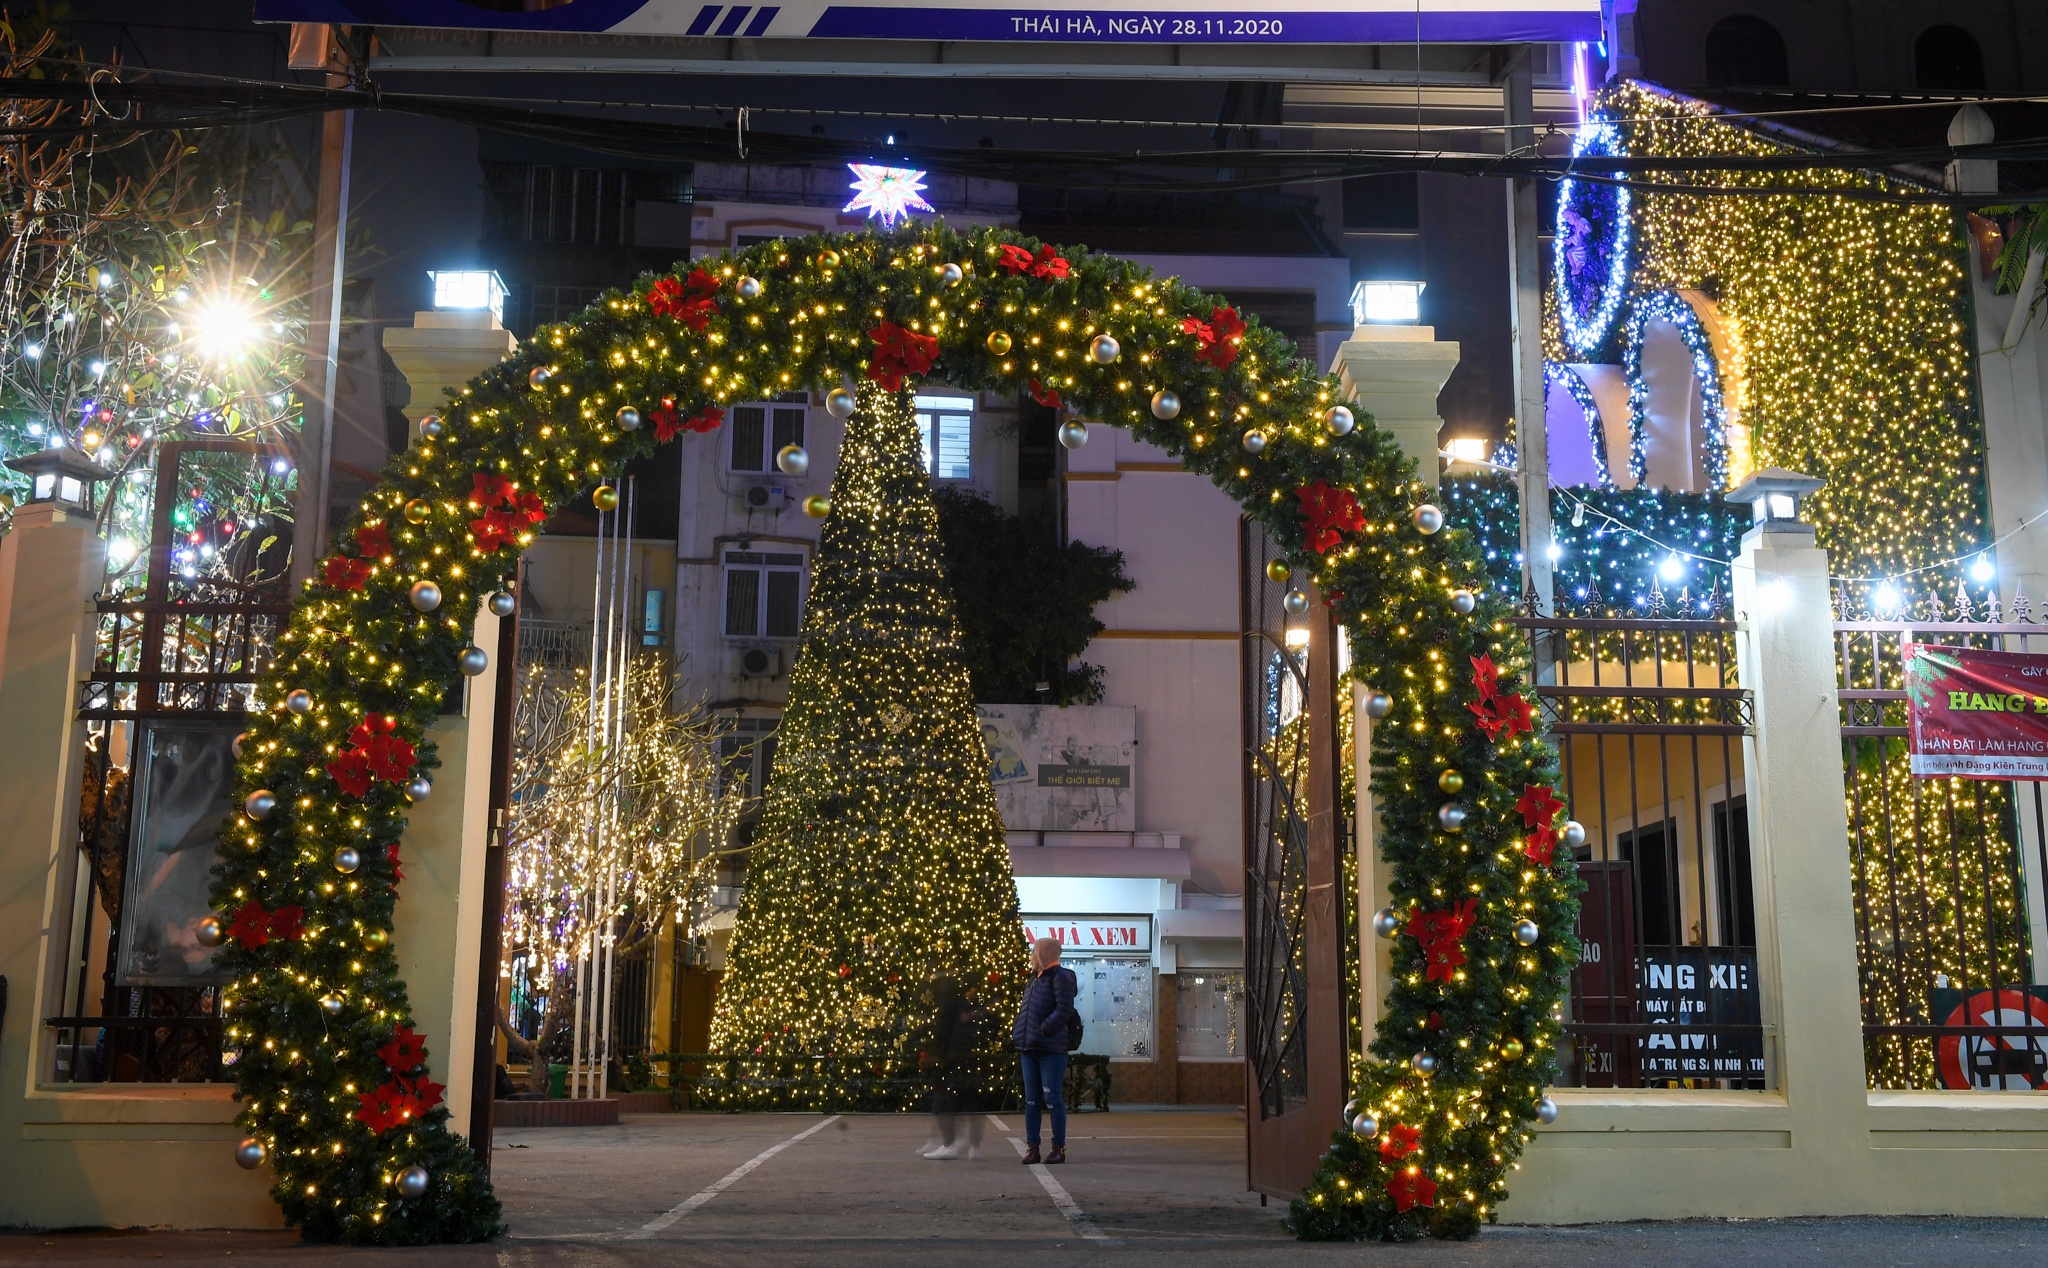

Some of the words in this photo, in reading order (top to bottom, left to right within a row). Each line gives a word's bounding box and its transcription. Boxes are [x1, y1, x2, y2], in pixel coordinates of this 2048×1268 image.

[1011, 15, 1060, 34] THÁI
[1066, 15, 1102, 36] HÀ,
[1108, 16, 1166, 35] NGÀY
[1172, 19, 1283, 36] 28.11.2020
[2021, 666, 2043, 676] GÂY
[1948, 691, 2026, 713] HANG
[1918, 738, 1950, 752] NHẬN
[1953, 738, 1975, 752] ĐẶT
[1978, 739, 2005, 751] LÀM
[2008, 741, 2044, 752] HANG
[1966, 761, 1991, 772] Đặng
[1994, 762, 2014, 770] Kiên
[2017, 762, 2044, 772] Trung
[1048, 921, 1082, 946] MÀ
[1090, 926, 1137, 946] XEM
[1579, 938, 1601, 963] ÀO
